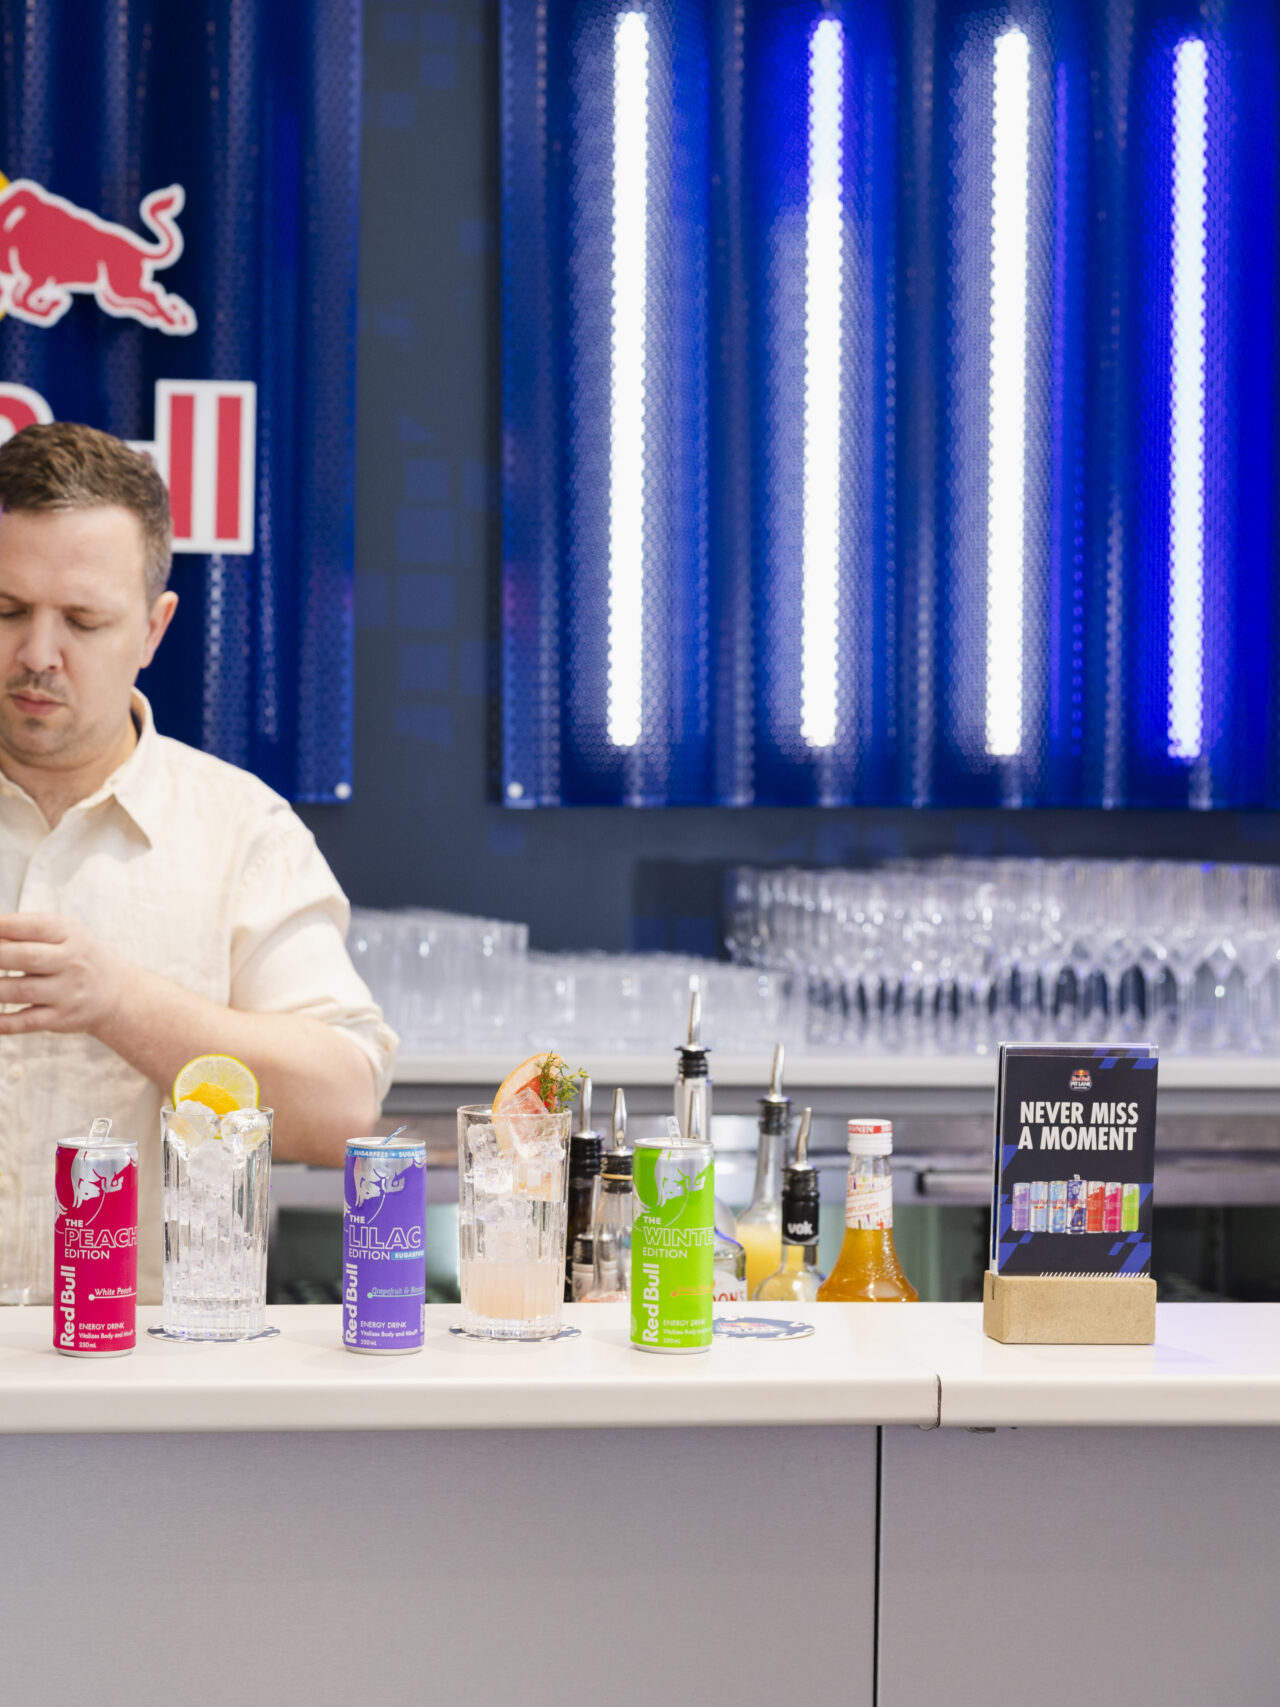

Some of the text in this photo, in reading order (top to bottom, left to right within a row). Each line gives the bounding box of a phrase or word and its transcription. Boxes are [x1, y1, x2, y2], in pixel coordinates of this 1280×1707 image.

[1020, 1101, 1139, 1125] NEVER MISS
[1017, 1126, 1137, 1151] A MOMENT
[64, 1218, 84, 1228] THE
[349, 1214, 366, 1224] THE
[643, 1216, 661, 1225] THE
[787, 1220, 813, 1235] vok
[64, 1225, 138, 1249] PEACH
[348, 1224, 421, 1250] LILAC
[643, 1225, 714, 1247] WINTE
[64, 1248, 110, 1260] EDITION
[348, 1248, 391, 1260] EDITION
[642, 1247, 688, 1258] EDITION
[95, 1286, 132, 1296] White Peach
[60, 1265, 76, 1347] Red Bull
[345, 1263, 358, 1344] Red Bull
[642, 1262, 660, 1343] Red Bull
[79, 1322, 125, 1330] ENERGY DRINK
[360, 1320, 407, 1328] ENERGY DRINK
